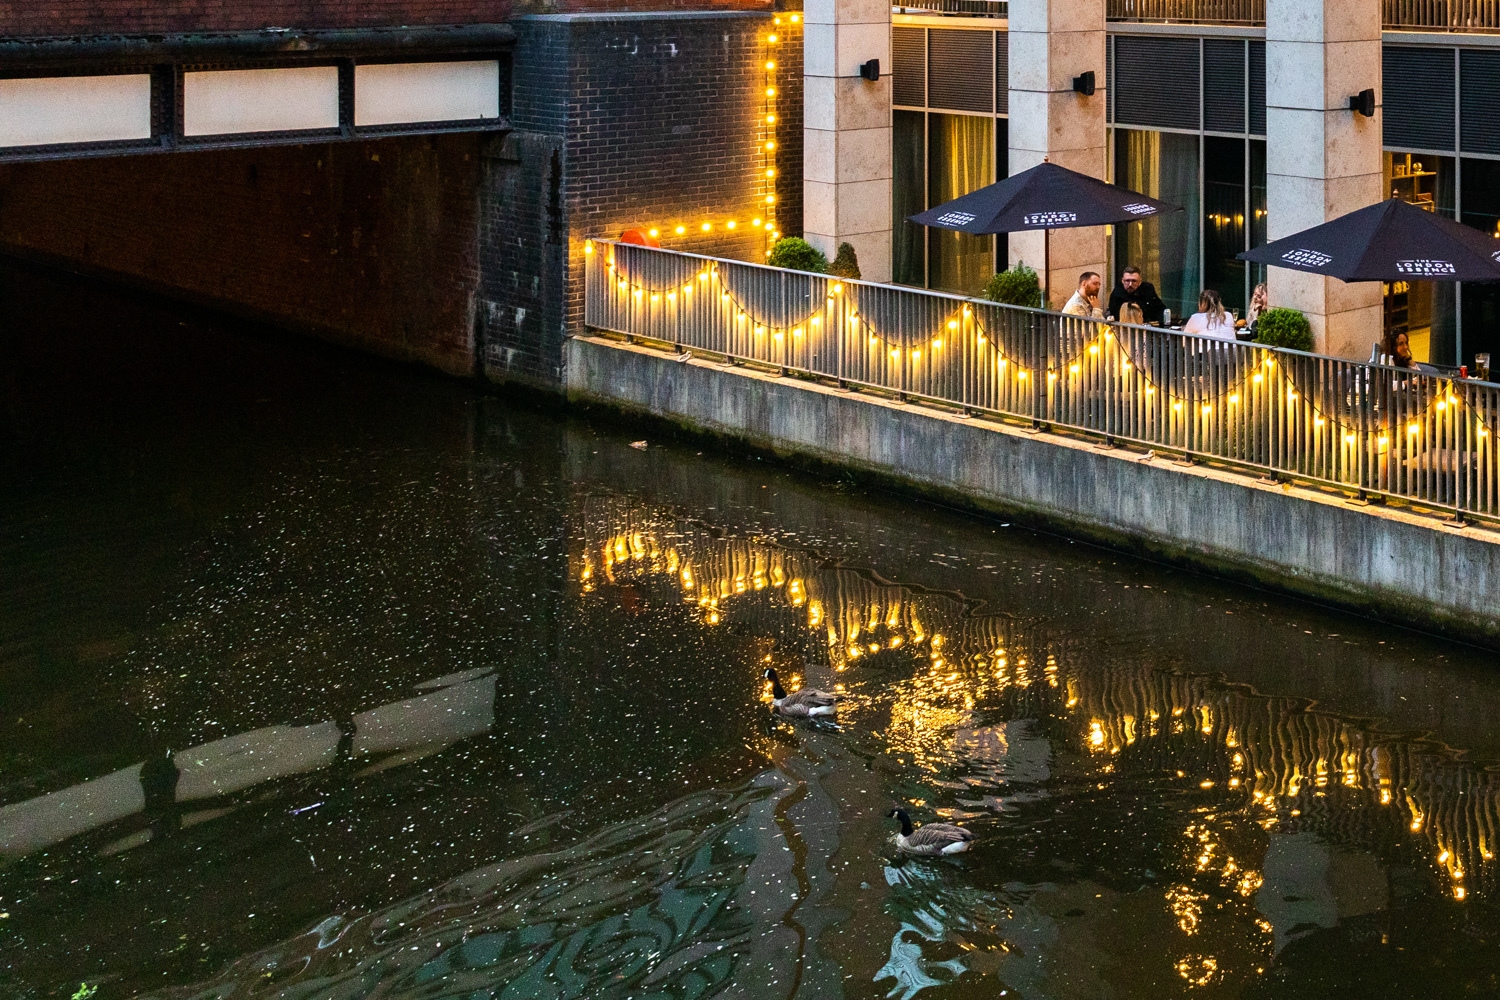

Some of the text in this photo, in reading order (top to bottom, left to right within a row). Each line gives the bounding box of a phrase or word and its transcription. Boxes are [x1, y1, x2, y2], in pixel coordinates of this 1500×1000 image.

[1024, 213, 1076, 221] LONDON
[1281, 253, 1325, 266] ESSENCE
[1289, 250, 1332, 263] LONDON
